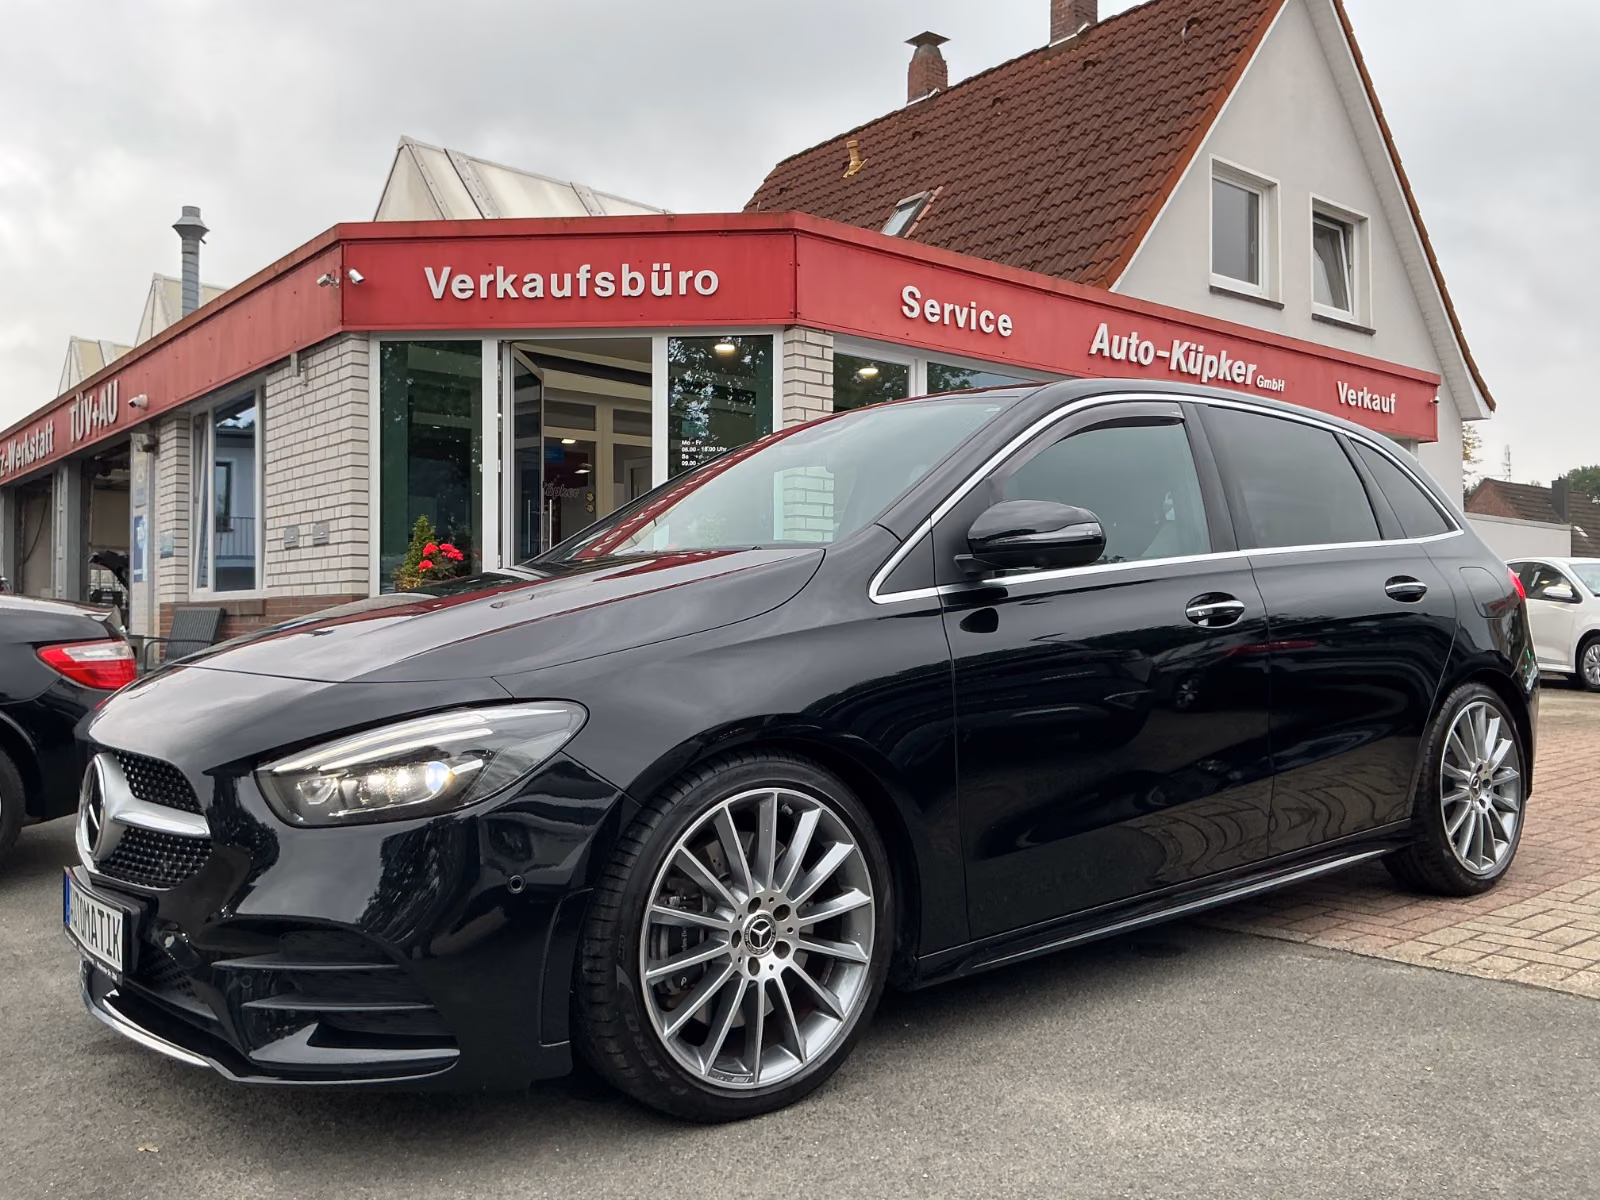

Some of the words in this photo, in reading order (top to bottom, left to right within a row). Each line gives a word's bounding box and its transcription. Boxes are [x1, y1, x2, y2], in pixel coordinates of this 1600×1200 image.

[424, 263, 719, 300] Verkaufsbüro
[901, 285, 1013, 337] Service
[1089, 323, 1257, 385] Auto-Küpker
[1256, 374, 1285, 392] GmbH
[69, 379, 119, 444] TÜV+AU
[1336, 380, 1396, 414] Verkauf
[0, 419, 54, 477] z-Werkstatt
